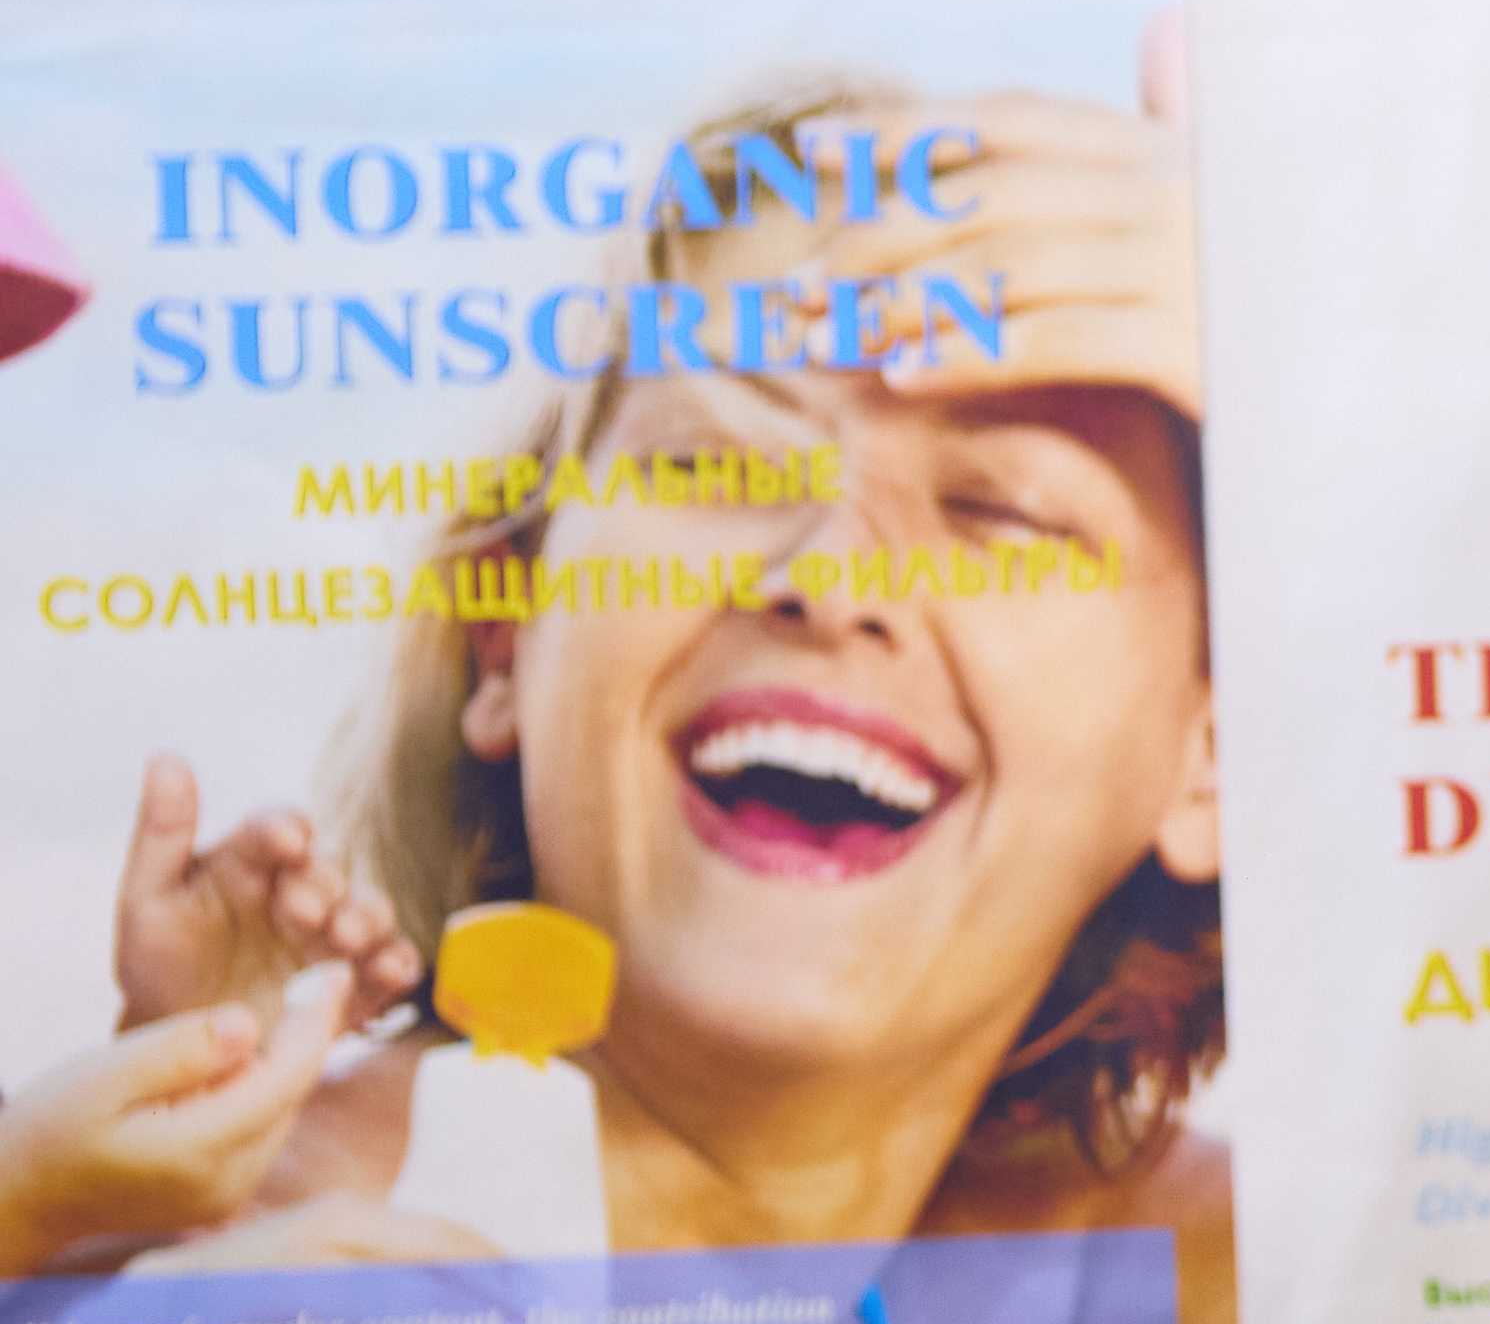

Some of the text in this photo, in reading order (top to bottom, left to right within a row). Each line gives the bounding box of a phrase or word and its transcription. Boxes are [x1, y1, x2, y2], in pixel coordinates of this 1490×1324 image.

[148, 125, 984, 250] INORGANIC
[133, 271, 1007, 398] SUNSCREEN
[294, 446, 845, 519] МИНЕРАЛЬНЫЕ
[38, 539, 1122, 633] СОЛНЦЕЗАЩИТНЫЕ ФИЛЬТРЫ
